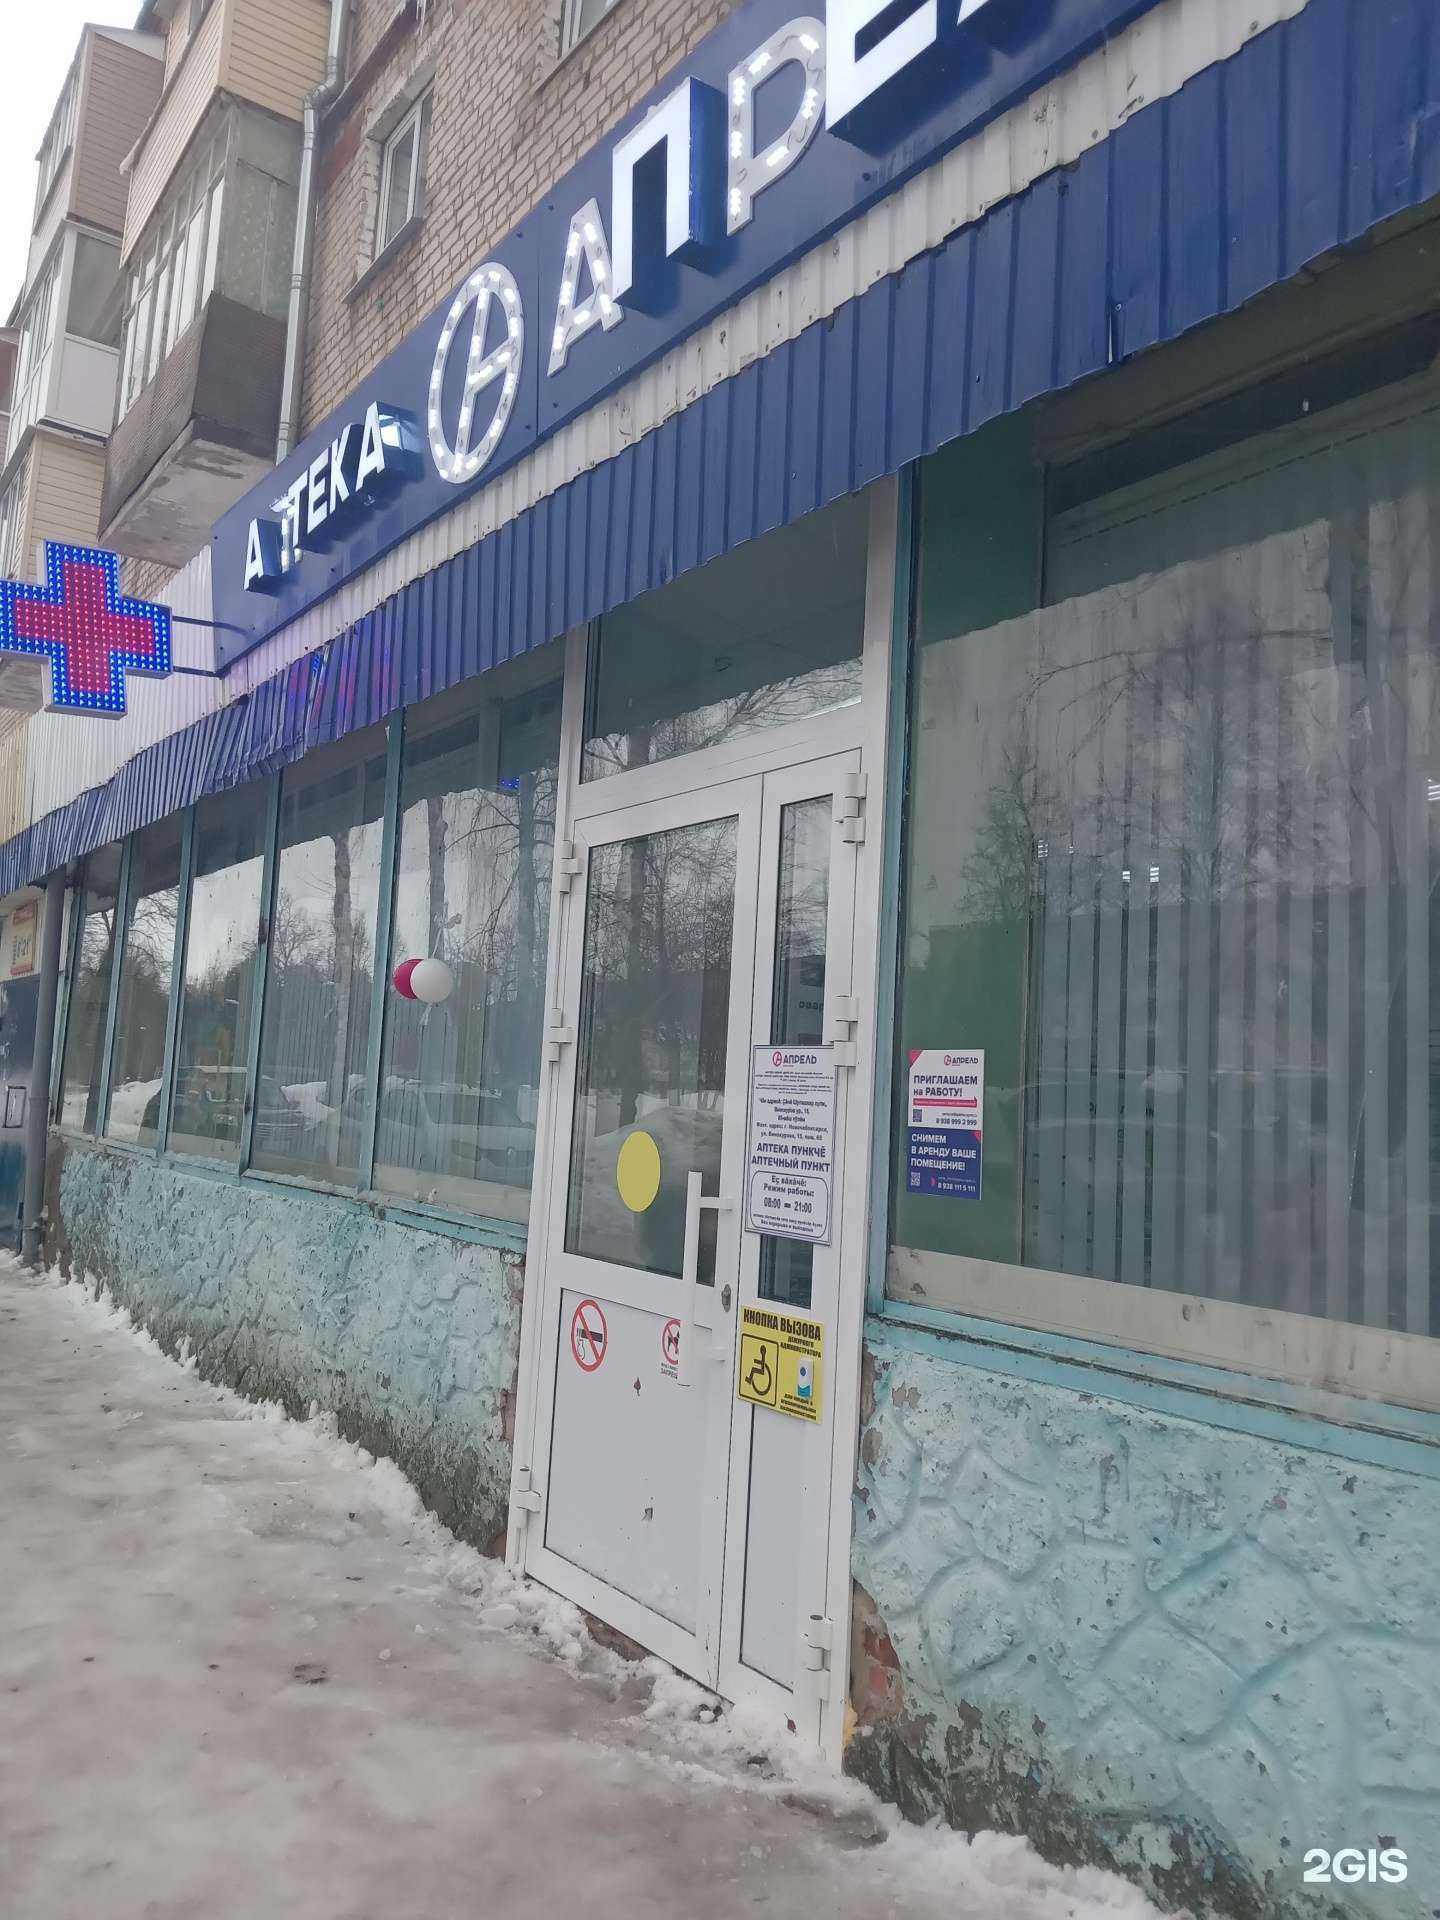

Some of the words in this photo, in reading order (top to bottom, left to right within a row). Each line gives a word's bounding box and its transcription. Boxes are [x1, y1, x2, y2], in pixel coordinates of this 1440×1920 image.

[547, 0, 990, 376] АПРЕ
[783, 1054, 817, 1064] АПРЕЛЬ
[952, 1056, 979, 1064] АПРЕЛЬ
[913, 1075, 978, 1085] ПРИГЛАШАЕМ
[925, 1087, 963, 1097] РАБОТУ!
[911, 1133, 947, 1144] СНИМЕМ
[757, 1142, 789, 1154] АПТЕКА
[911, 1146, 917, 1155] В
[918, 1146, 950, 1158] АРЕНДУ
[952, 1148, 977, 1159] ВАШЕ
[751, 1155, 798, 1169] АПТЕЧНЫЙ
[801, 1160, 830, 1172] ПУНКТ
[910, 1157, 966, 1171] ПОМЕЩЕНИЕ!
[763, 1183, 785, 1193] Режим
[787, 1187, 814, 1197] работы:
[763, 1196, 781, 1209] 08:00
[794, 1200, 812, 1213] 21:00
[743, 1308, 778, 1331] КНОПКА
[780, 1317, 821, 1341] ВЫЗОВА
